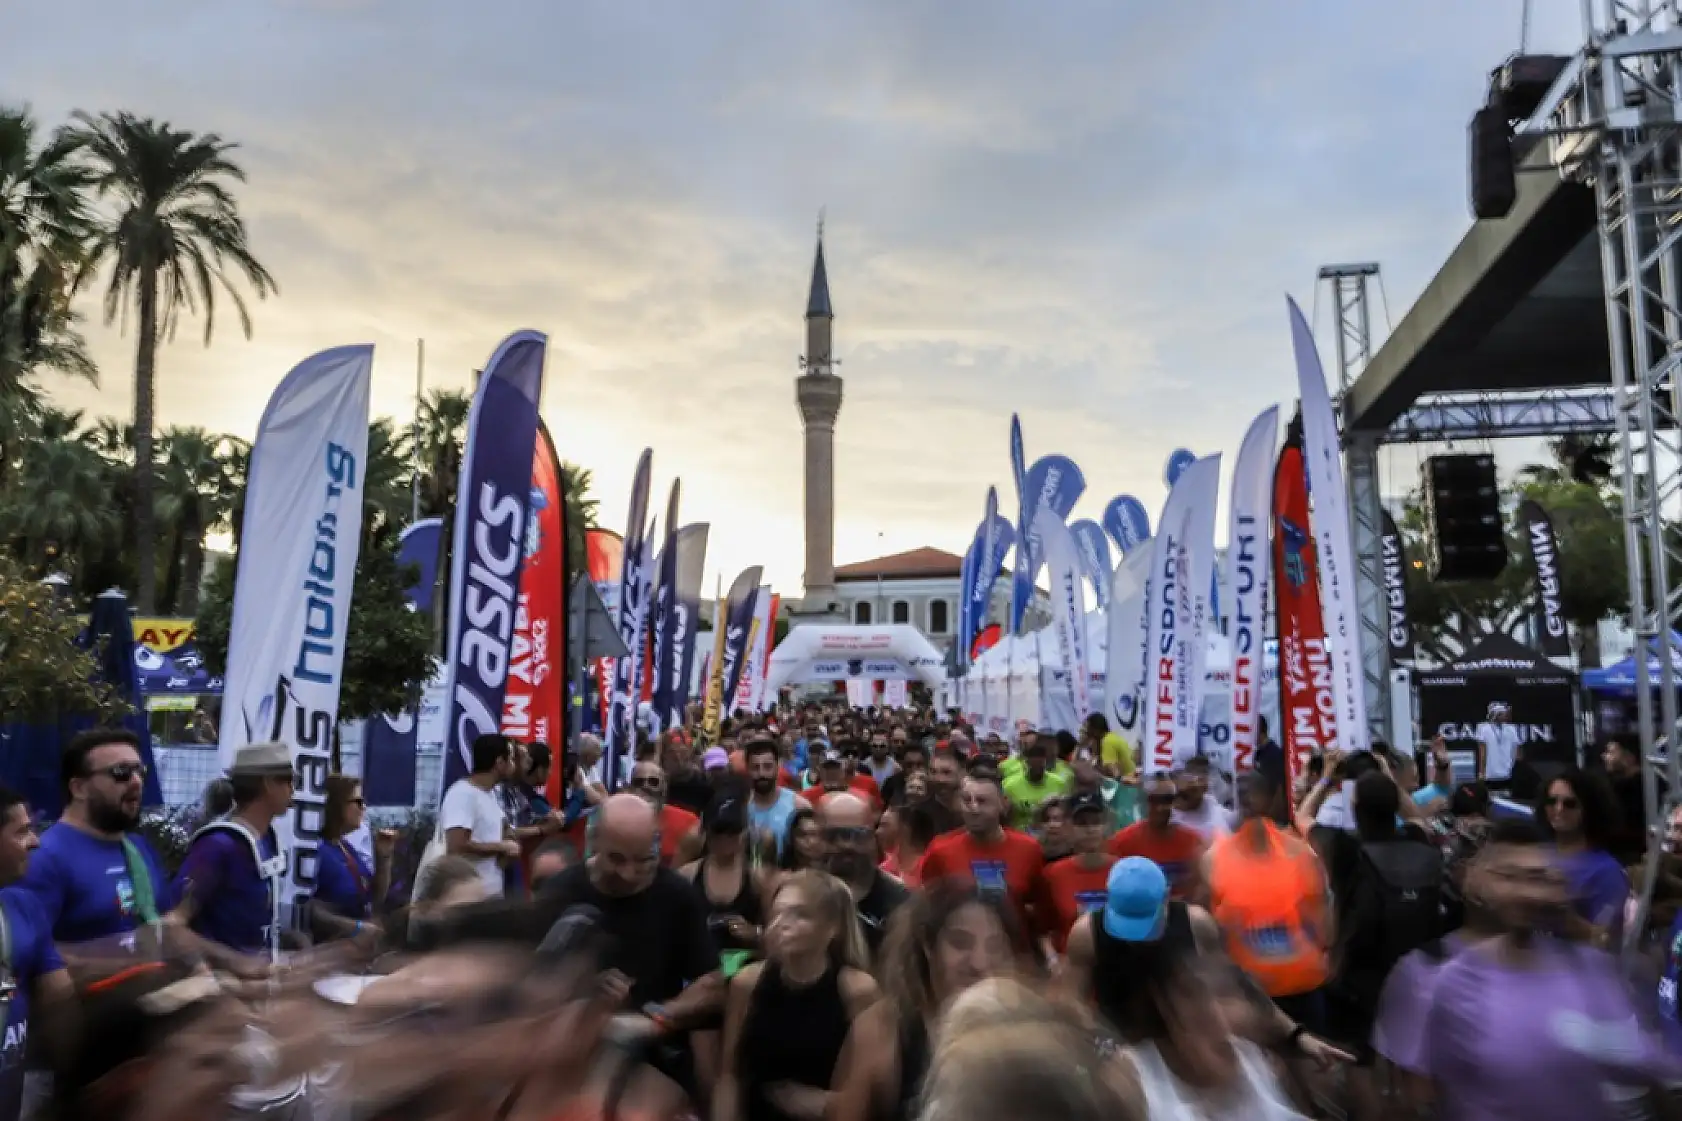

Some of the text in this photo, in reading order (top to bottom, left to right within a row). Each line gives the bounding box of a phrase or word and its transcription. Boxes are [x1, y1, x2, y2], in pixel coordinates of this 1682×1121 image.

[460, 482, 524, 691] asics
[1233, 514, 1255, 773] NTERSPORT
[1439, 722, 1556, 743] GAIN
